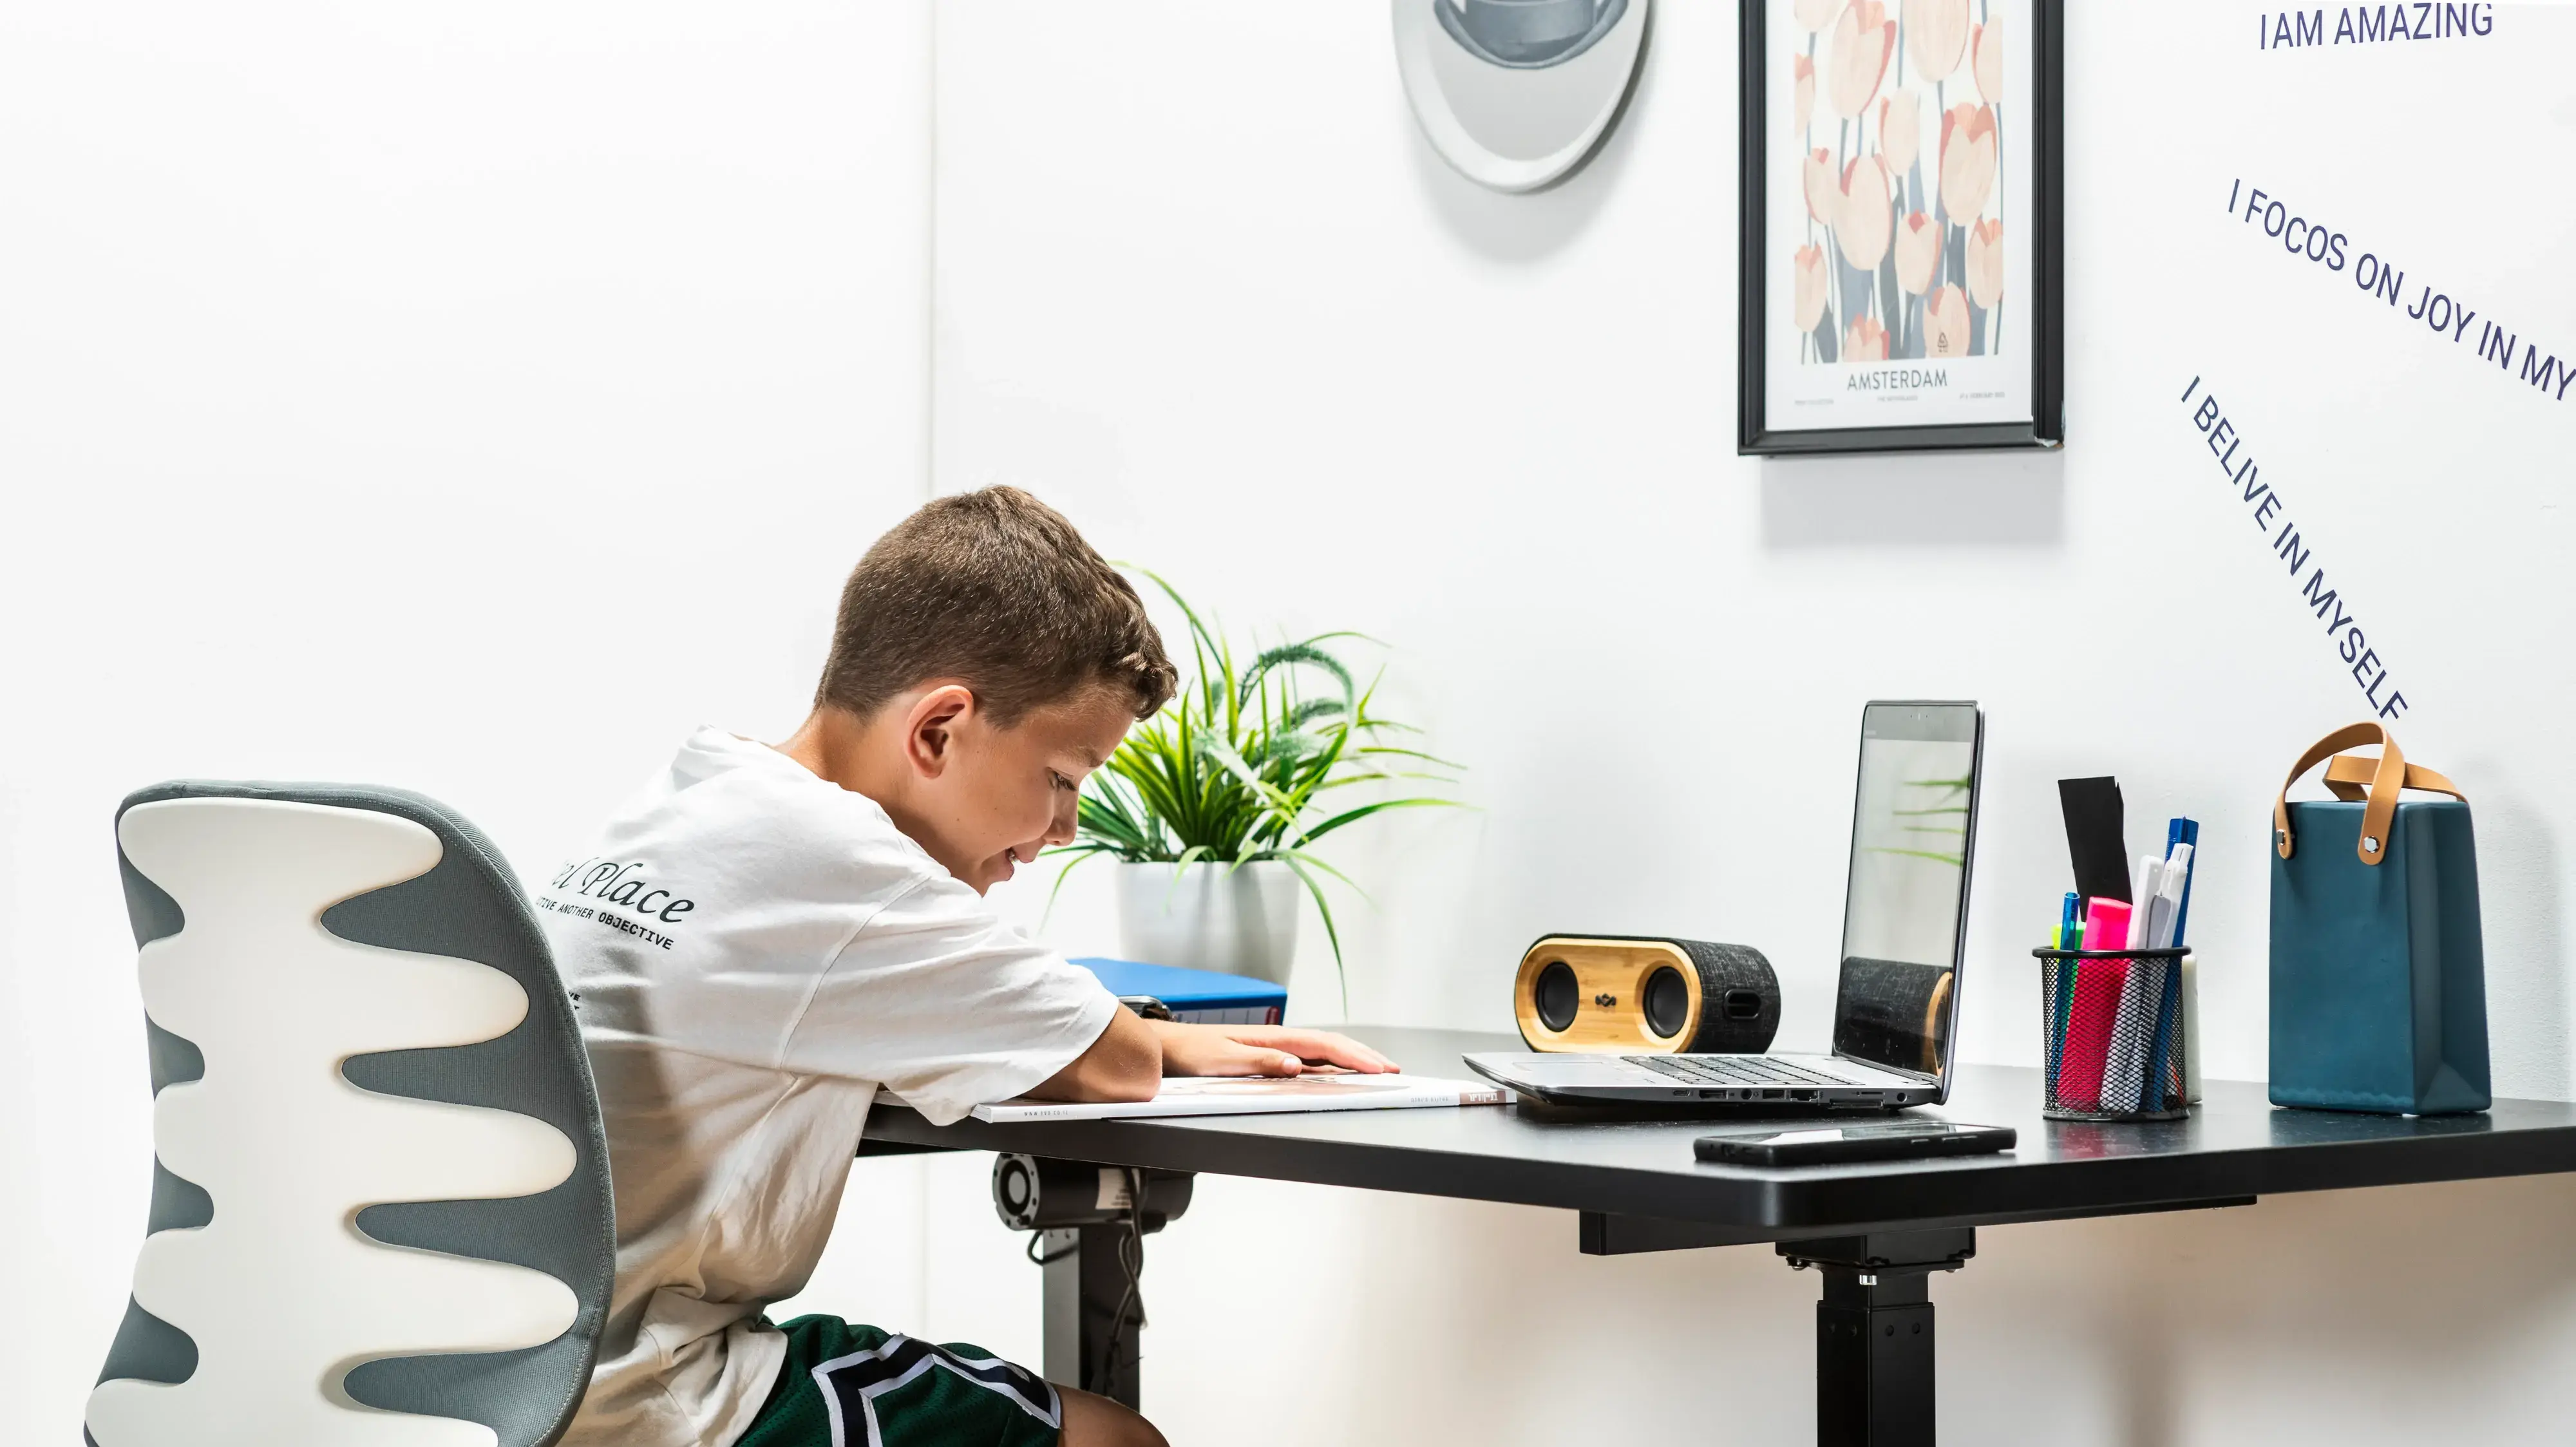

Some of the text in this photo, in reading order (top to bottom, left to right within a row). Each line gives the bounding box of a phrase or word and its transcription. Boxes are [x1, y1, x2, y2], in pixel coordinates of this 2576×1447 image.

[2260, 3, 2493, 50] I AM AMAZING
[2228, 178, 2576, 401] I FOCOS ON JOY IN MY
[1847, 369, 1948, 391] AMSTERDAM
[2181, 375, 2409, 720] I BELIVE IN MYSELF
[577, 862, 695, 923] Place
[557, 903, 594, 920] ANOTHER
[598, 912, 674, 950] OBJECTIVE
